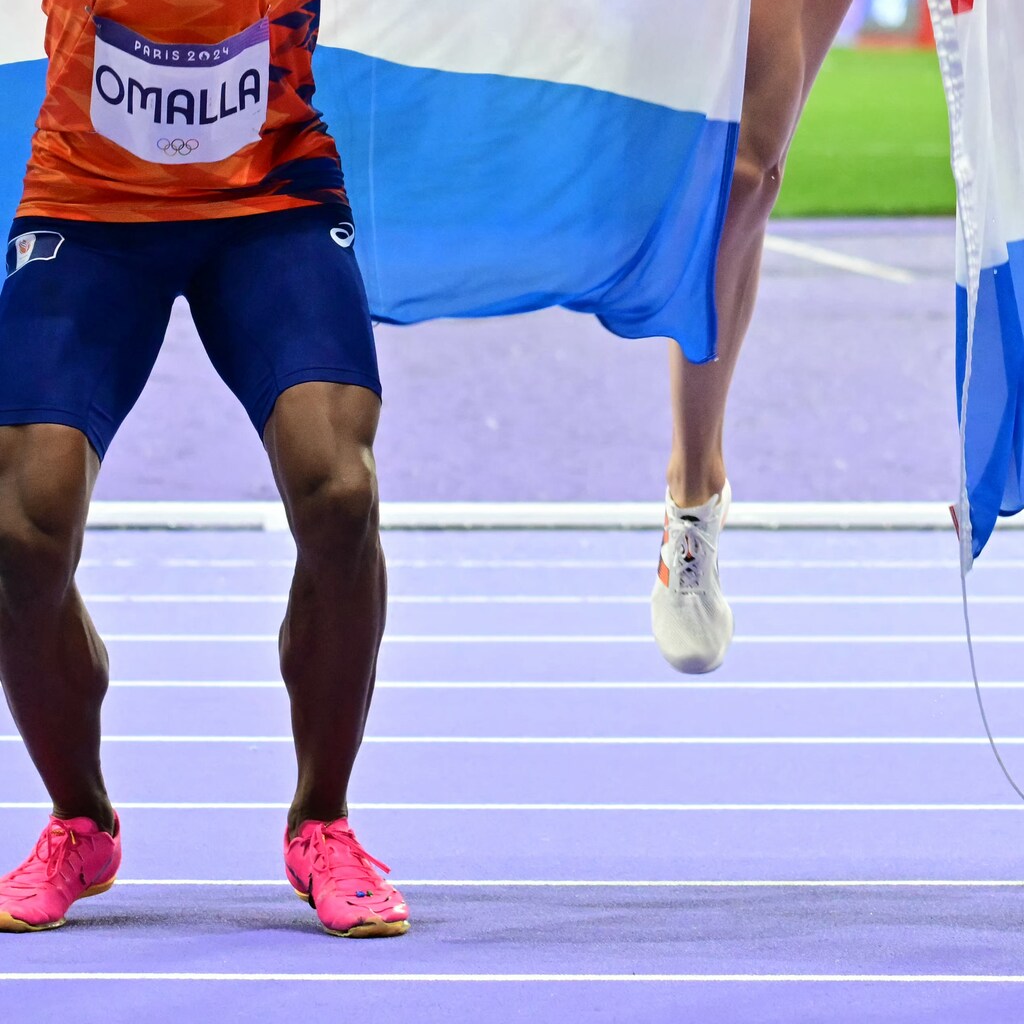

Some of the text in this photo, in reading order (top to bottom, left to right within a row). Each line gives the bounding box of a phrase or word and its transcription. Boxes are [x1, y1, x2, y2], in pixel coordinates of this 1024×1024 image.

[134, 39, 230, 62] PARIS 2024
[95, 64, 261, 125] OMALLA
